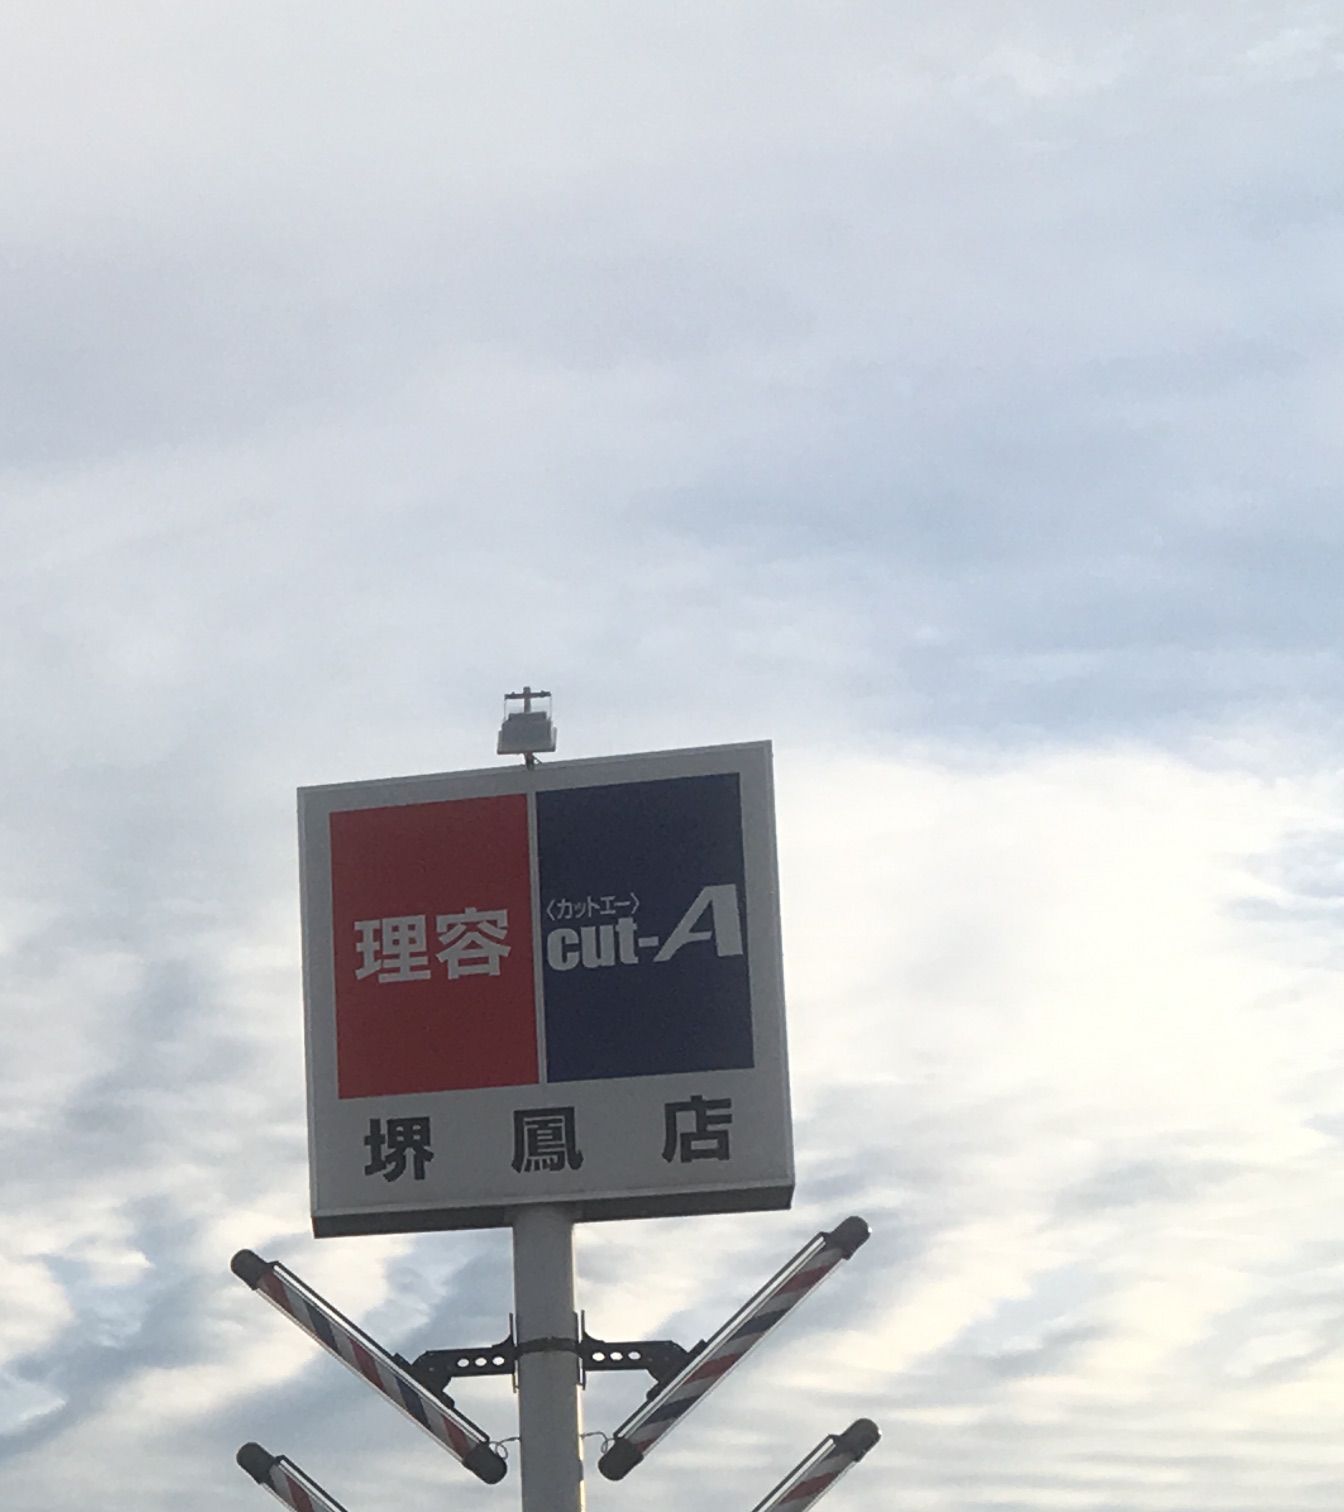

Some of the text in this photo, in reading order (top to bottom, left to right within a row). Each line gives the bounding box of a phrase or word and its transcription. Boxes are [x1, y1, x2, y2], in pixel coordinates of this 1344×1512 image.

[354, 907, 511, 984] 理容
[547, 883, 744, 972] cut-A
[363, 1095, 733, 1183] 堺鳳店
